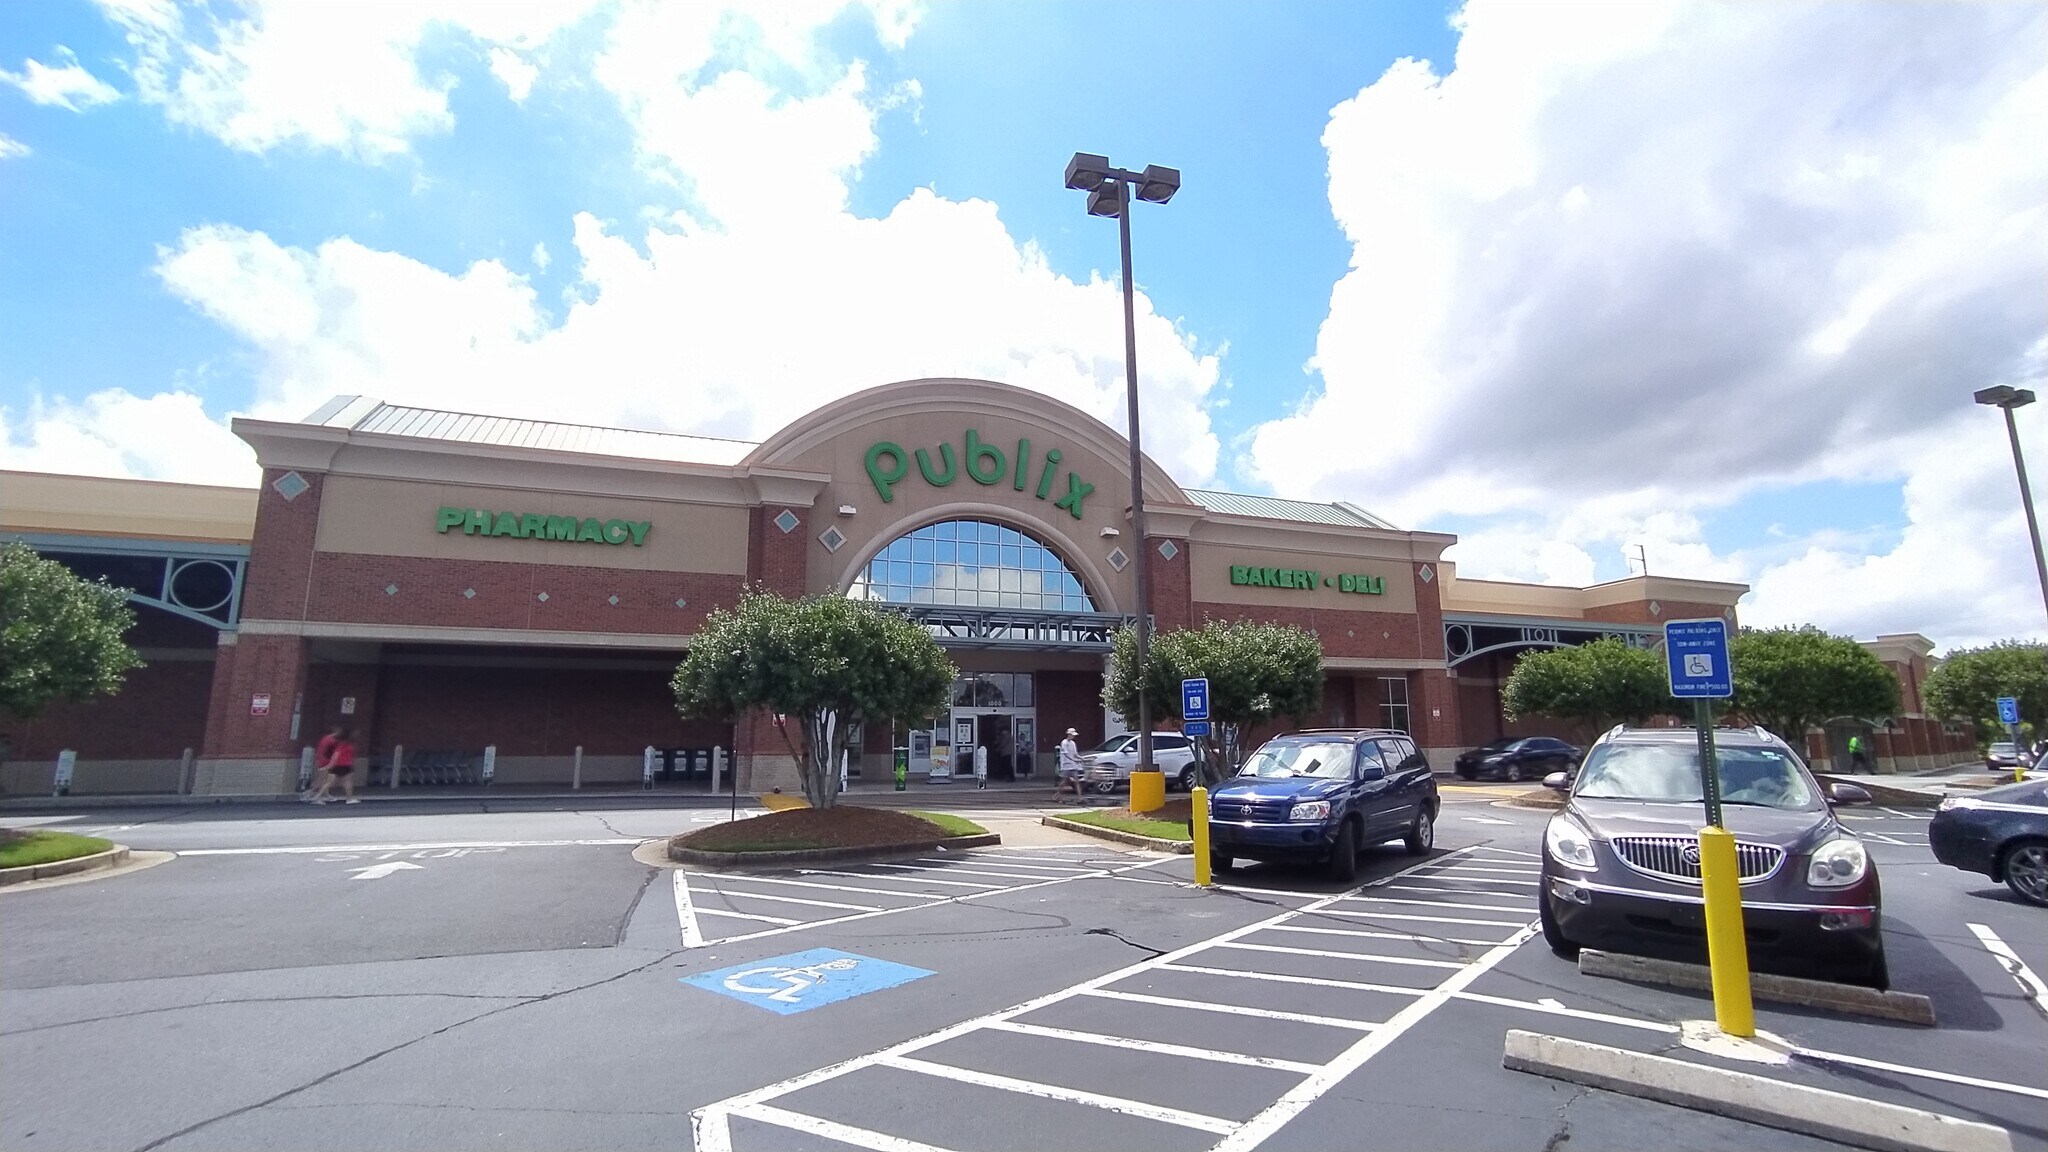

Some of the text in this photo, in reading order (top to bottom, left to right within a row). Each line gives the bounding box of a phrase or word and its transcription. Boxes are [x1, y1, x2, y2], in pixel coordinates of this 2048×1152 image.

[437, 506, 652, 546] PHARMACY
[1230, 564, 1386, 595] BAKERY DELI
[314, 846, 507, 862] STOP
